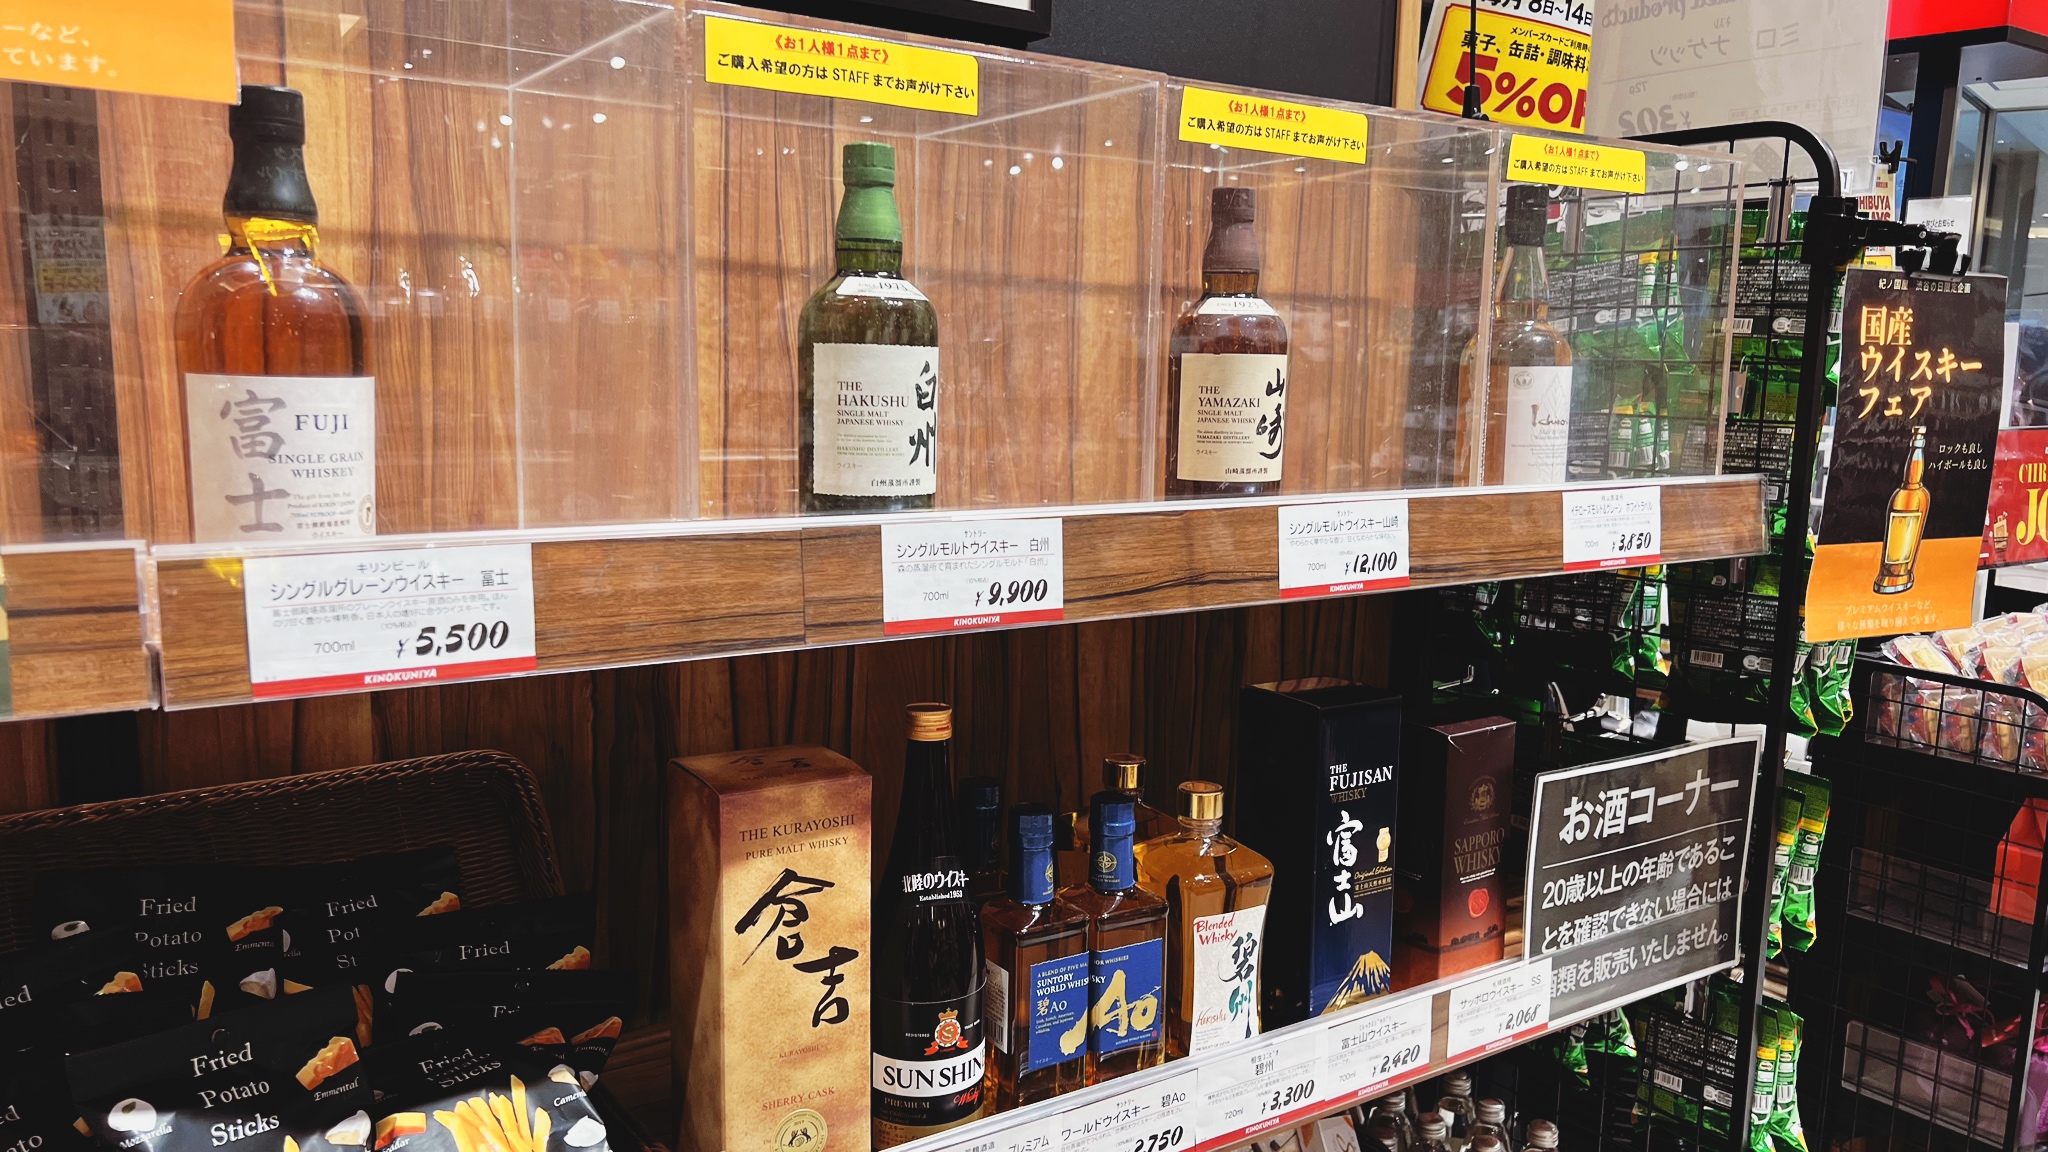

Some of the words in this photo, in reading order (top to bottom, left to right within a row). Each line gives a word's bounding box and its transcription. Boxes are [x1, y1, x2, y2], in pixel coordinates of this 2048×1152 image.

[1510, 27, 1590, 52] メンバーズカードご利用時
[1460, 30, 1589, 73] 菓子、缶詰・調味料
[3, 48, 118, 78] ています。
[717, 53, 828, 80] ご購入希望の方は
[832, 67, 870, 85] STAFF
[872, 73, 974, 99] までお声がけ下さい
[1187, 117, 1262, 137] ご購入希望の方は
[1265, 127, 1291, 141] STAFF
[1293, 132, 1364, 150] までお声がけ下さい
[1513, 159, 1568, 174] ご購入希望の方は
[1569, 165, 1588, 176] STAFF
[1590, 168, 1643, 182] までお声がけ下さい
[1857, 195, 1891, 210] HIBUYA
[1860, 305, 1914, 346] 国産
[1861, 346, 1982, 383] ウイスキー
[837, 381, 863, 391] THE
[1198, 386, 1220, 395] THE
[837, 395, 910, 408] HAKUSHU
[1198, 397, 1260, 408] YAMAZAKI
[1857, 386, 1931, 419] フェア
[294, 413, 350, 434] FUJI
[837, 410, 866, 418] SINGLE
[867, 410, 889, 418] MALT
[837, 418, 875, 426] JAPANESE
[876, 419, 905, 427] WHISKY
[908, 360, 937, 474] 白州
[268, 454, 326, 464] SINGLE
[329, 451, 364, 463] GRAIN
[1938, 442, 1983, 454] ロックも良し
[219, 389, 292, 533] 富士
[1928, 458, 1988, 470] ハイボールも良し
[291, 467, 355, 479] WHISKEY
[2019, 463, 2048, 483] CHR
[1289, 515, 1399, 535] シングルモルトウイスキー山崎
[896, 539, 1019, 559] シングルモルトウイスキー
[1029, 537, 1049, 552] 白州
[1612, 532, 1652, 552] ¥3,850
[357, 560, 430, 573] キリンビール
[1307, 562, 1327, 571] 700ml
[1344, 551, 1398, 575] ¥12,100
[270, 572, 465, 601] シングルグレーンウイスキー
[480, 568, 509, 587] 富士
[975, 578, 1048, 607] ¥9,900
[923, 591, 949, 601] 700ml
[953, 615, 1001, 627] KINOKUNIYA
[314, 640, 355, 655] 700ml
[397, 620, 509, 658] ¥5,500
[364, 668, 438, 685] KINOKUNIYA
[1329, 763, 1348, 775] THE
[1329, 765, 1393, 793] FUJISAN
[1330, 787, 1368, 804] WHISKY
[1559, 769, 1739, 845] お酒コーナー
[739, 827, 768, 842] THE
[773, 814, 855, 836] KURAYOSHI
[745, 847, 773, 860] PURE
[776, 843, 805, 856] MALT
[808, 836, 849, 850] WHISKY
[1454, 827, 1505, 855] SAPPORO
[1326, 809, 1364, 926] 富士山
[1453, 845, 1504, 875] WHISKY
[1542, 835, 1736, 909] 20歳以上の年齢であるこ
[139, 896, 196, 917] Fried
[325, 895, 378, 918] Fried
[1541, 875, 1732, 955] とを確認できない場合には
[1194, 911, 1235, 933] Blended
[135, 931, 202, 948] Potato
[235, 939, 275, 952] Emmenta
[327, 927, 361, 944] Pot
[1198, 929, 1238, 948] Whisky
[459, 940, 510, 961] Fried
[1037, 972, 1074, 988] SUNTORY
[1042, 969, 1059, 977] BLEND
[1036, 984, 1066, 997] WORLD
[1460, 982, 1524, 1009] サッポロウイスキー
[1530, 974, 1542, 987] SS
[1341, 1021, 1407, 1050] 富士山ウイスキー
[190, 1042, 253, 1078] Fried
[418, 1048, 475, 1074] Fried
[779, 1045, 820, 1058] KURAYOSHI
[1372, 1044, 1420, 1077] ¥2,420
[1255, 1059, 1274, 1075] 碧州
[1338, 1071, 1357, 1082] 700ml
[197, 1079, 270, 1109] Potato
[314, 1080, 359, 1102] Emmental
[553, 1090, 587, 1107] Camem
[761, 1093, 805, 1111] SHERRY
[808, 1086, 835, 1100] CASK
[1261, 1079, 1315, 1115] ¥3,300
[1357, 1080, 1389, 1096] KINOKUNIYA
[884, 1097, 930, 1109] PREMIUM
[1061, 1104, 1150, 1141] ワールドウイスキー
[1224, 1108, 1244, 1120] 720ml
[120, 1121, 173, 1150] Mozzarella
[210, 1113, 280, 1148] Sticks
[1245, 1117, 1280, 1135] KINOKUNIYA
